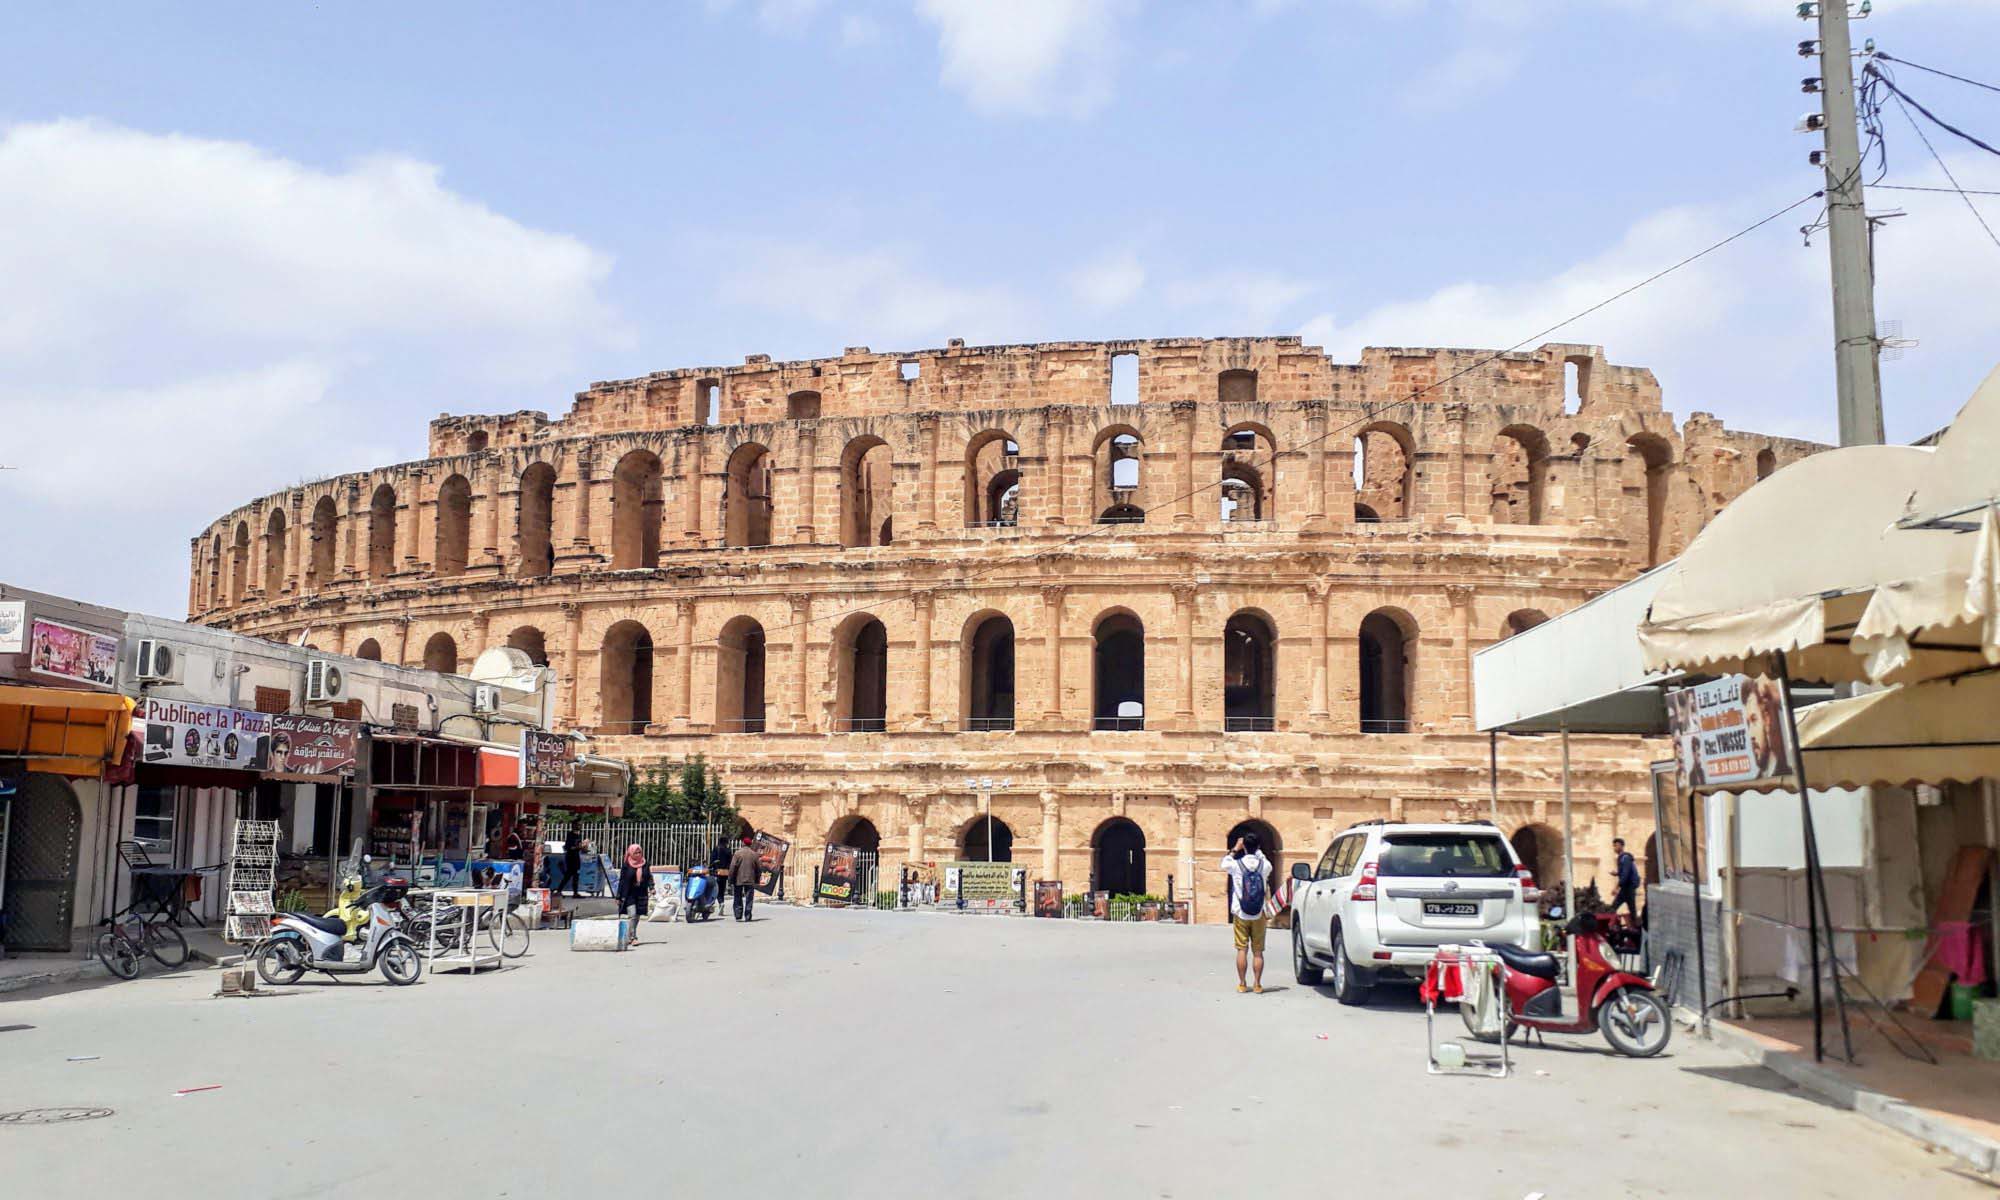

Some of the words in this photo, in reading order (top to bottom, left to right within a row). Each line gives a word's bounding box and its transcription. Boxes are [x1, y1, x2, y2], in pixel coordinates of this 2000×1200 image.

[149, 700, 212, 727] Publinet
[216, 710, 228, 729] la
[233, 711, 271, 734] Piazza
[273, 717, 295, 731] Salle
